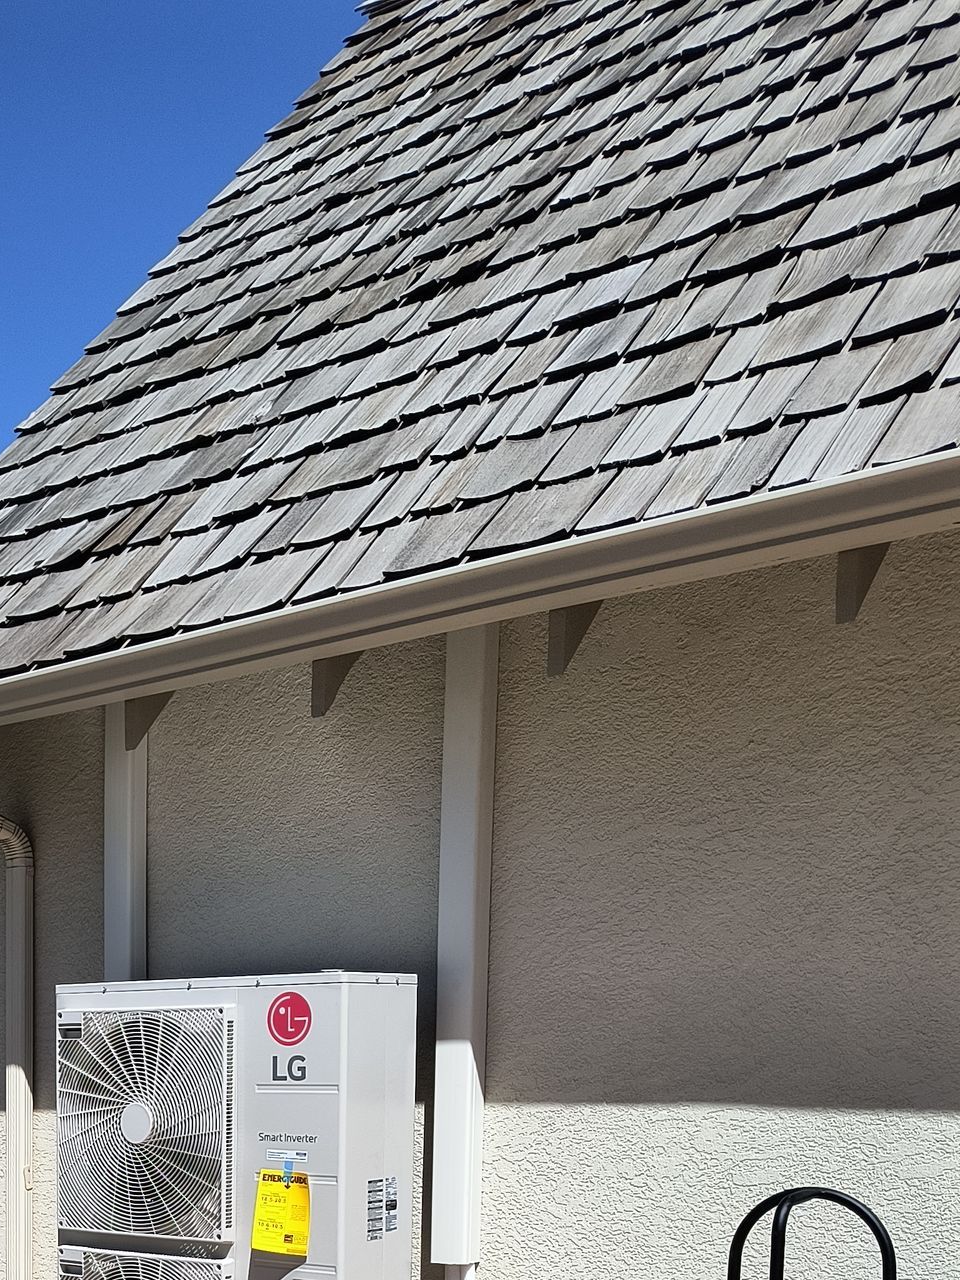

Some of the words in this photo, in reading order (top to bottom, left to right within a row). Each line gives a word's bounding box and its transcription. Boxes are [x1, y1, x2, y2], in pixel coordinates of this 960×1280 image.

[272, 1055, 306, 1081] LG
[258, 1132, 283, 1142] Smart
[284, 1133, 318, 1143] Inverter
